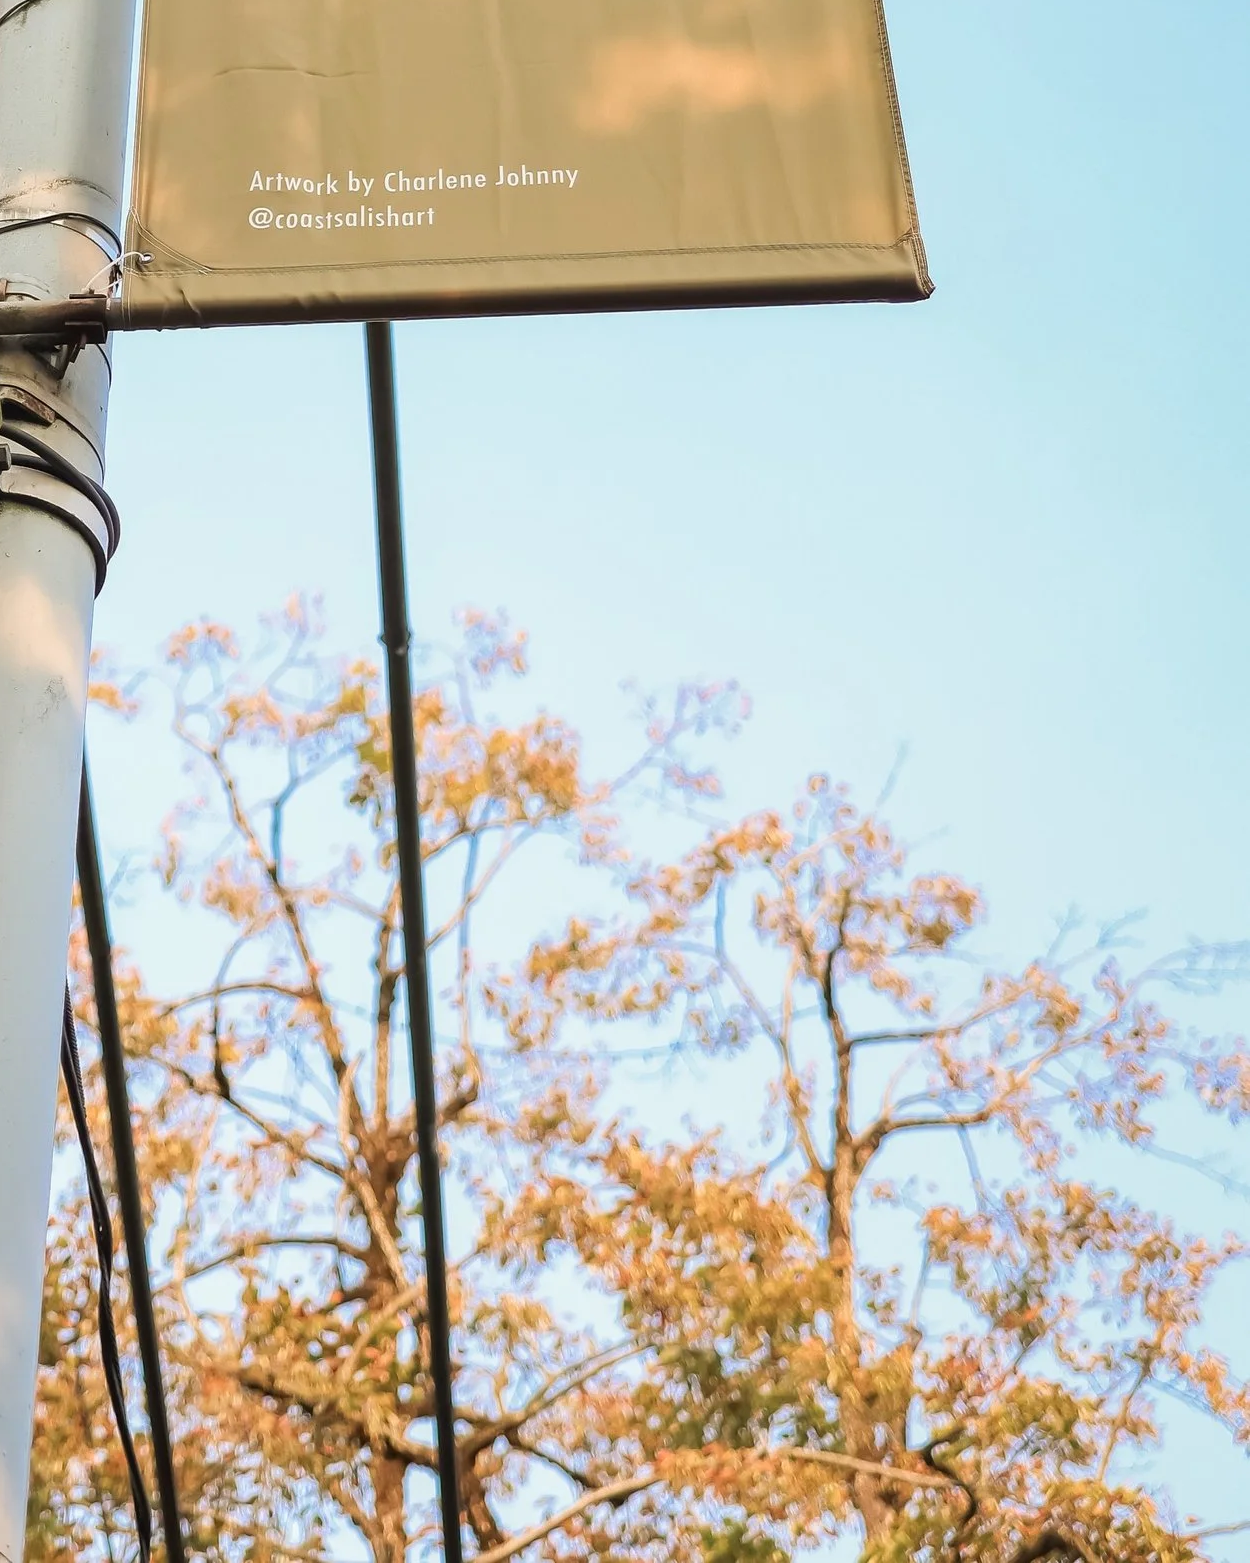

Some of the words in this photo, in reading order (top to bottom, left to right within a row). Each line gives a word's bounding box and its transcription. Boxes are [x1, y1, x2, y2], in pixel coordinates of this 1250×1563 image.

[249, 170, 339, 196] Artwork
[348, 170, 374, 196] by
[384, 168, 487, 193] Charlene
[495, 164, 579, 188] Johnny
[248, 204, 435, 230] @coastsalishart
